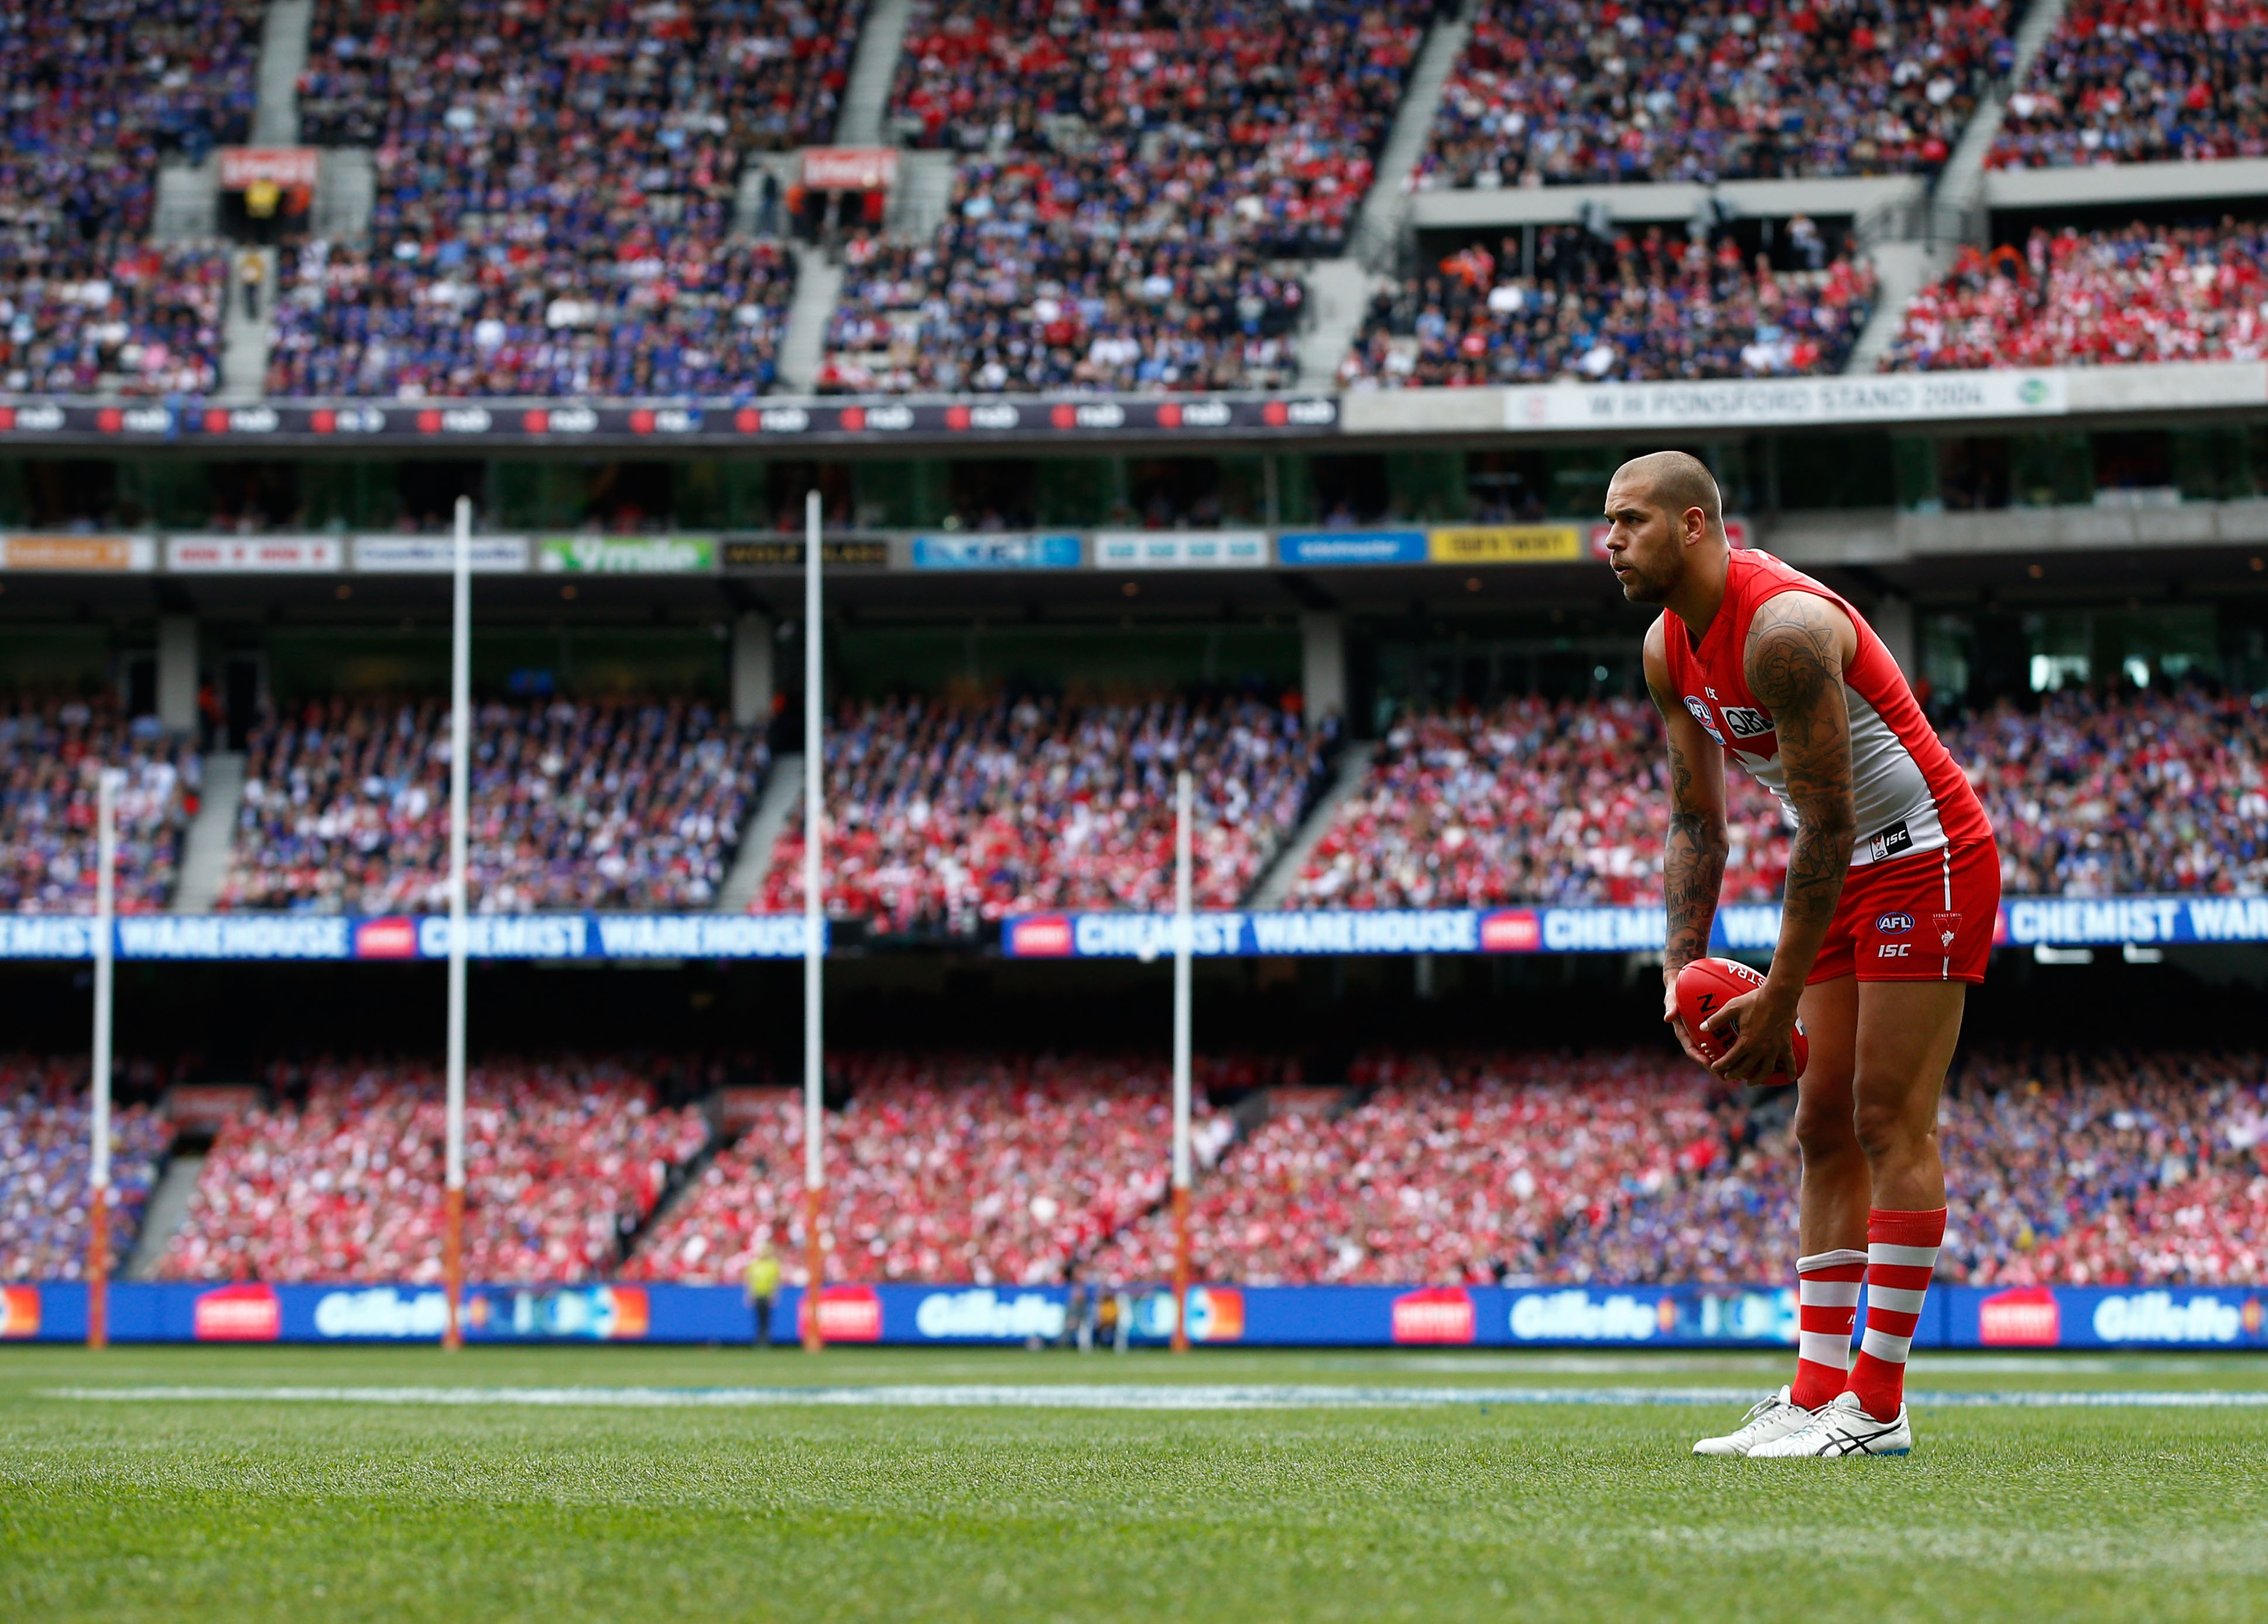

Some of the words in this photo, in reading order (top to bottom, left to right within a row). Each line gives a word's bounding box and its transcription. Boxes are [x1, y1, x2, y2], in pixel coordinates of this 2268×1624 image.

[1649, 389, 1811, 413] PONSFORD
[1819, 384, 1913, 410] STAND
[1690, 703, 1709, 720] AFL
[1886, 830, 1906, 847] ISC
[119, 915, 348, 957] WAREHOUSE
[419, 916, 585, 957] CEMIST
[1075, 913, 1244, 955] CHEMST
[1251, 911, 1476, 954] WAREHOUSE
[1880, 917, 1911, 929] AFL
[2010, 900, 2178, 943] CHEMIST
[1878, 944, 1911, 958] ISC
[1510, 1290, 1657, 1341] Gillette
[2092, 1290, 2240, 1342] Gillette
